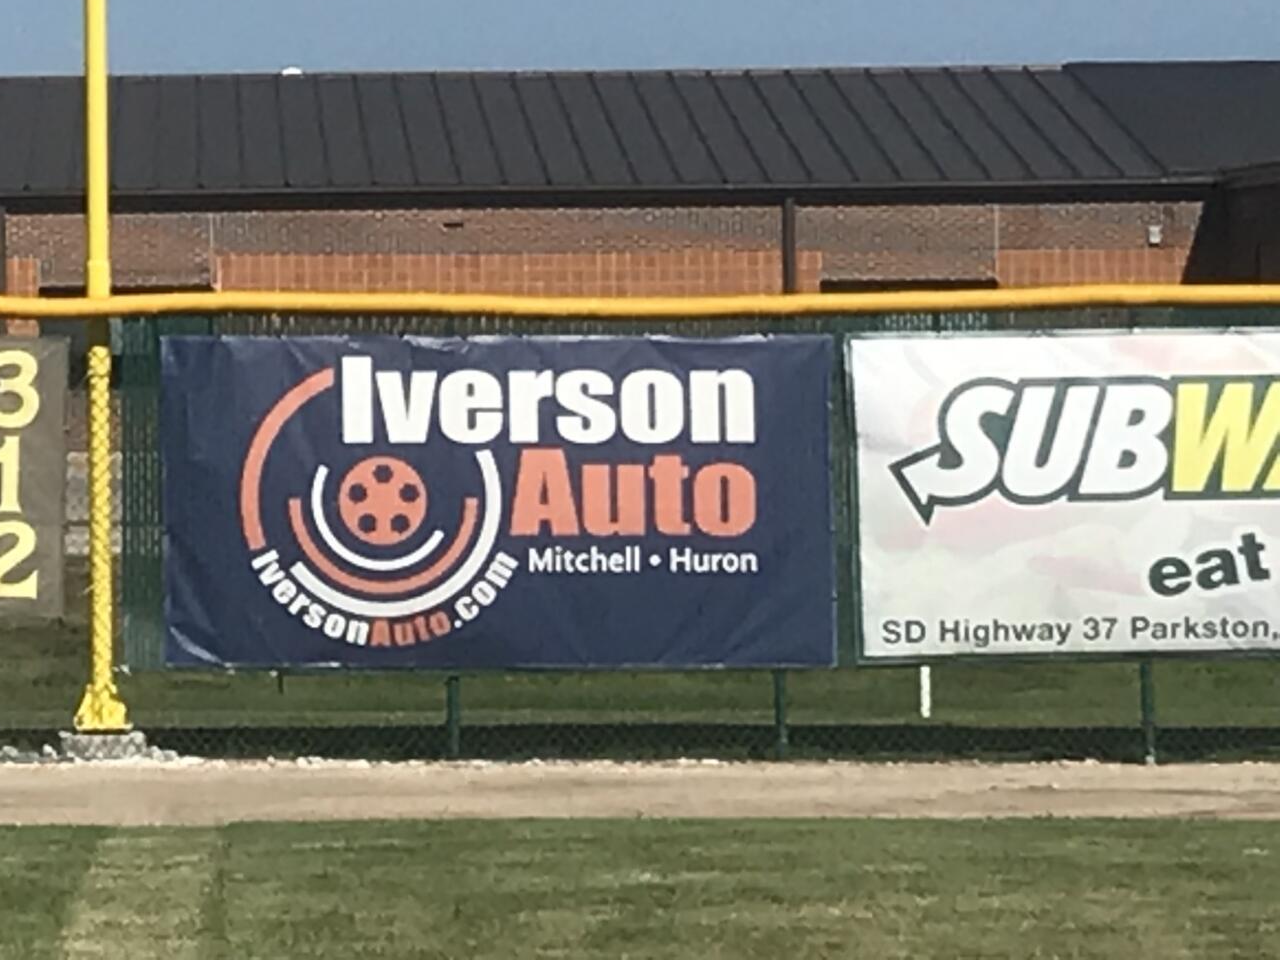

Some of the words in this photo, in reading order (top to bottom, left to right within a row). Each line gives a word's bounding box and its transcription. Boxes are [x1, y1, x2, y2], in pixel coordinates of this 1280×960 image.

[341, 355, 756, 445] Iverson
[510, 447, 758, 538] Auto
[889, 374, 1280, 525] SUBW
[251, 549, 519, 647] IversonAuto.com
[527, 545, 641, 573] Mitchell
[669, 547, 759, 573] Huron
[1147, 531, 1271, 598] eat
[882, 619, 927, 645] SD
[939, 618, 1072, 648] Highway
[1082, 617, 1119, 641] 37
[1130, 615, 1280, 641] Parkston,
